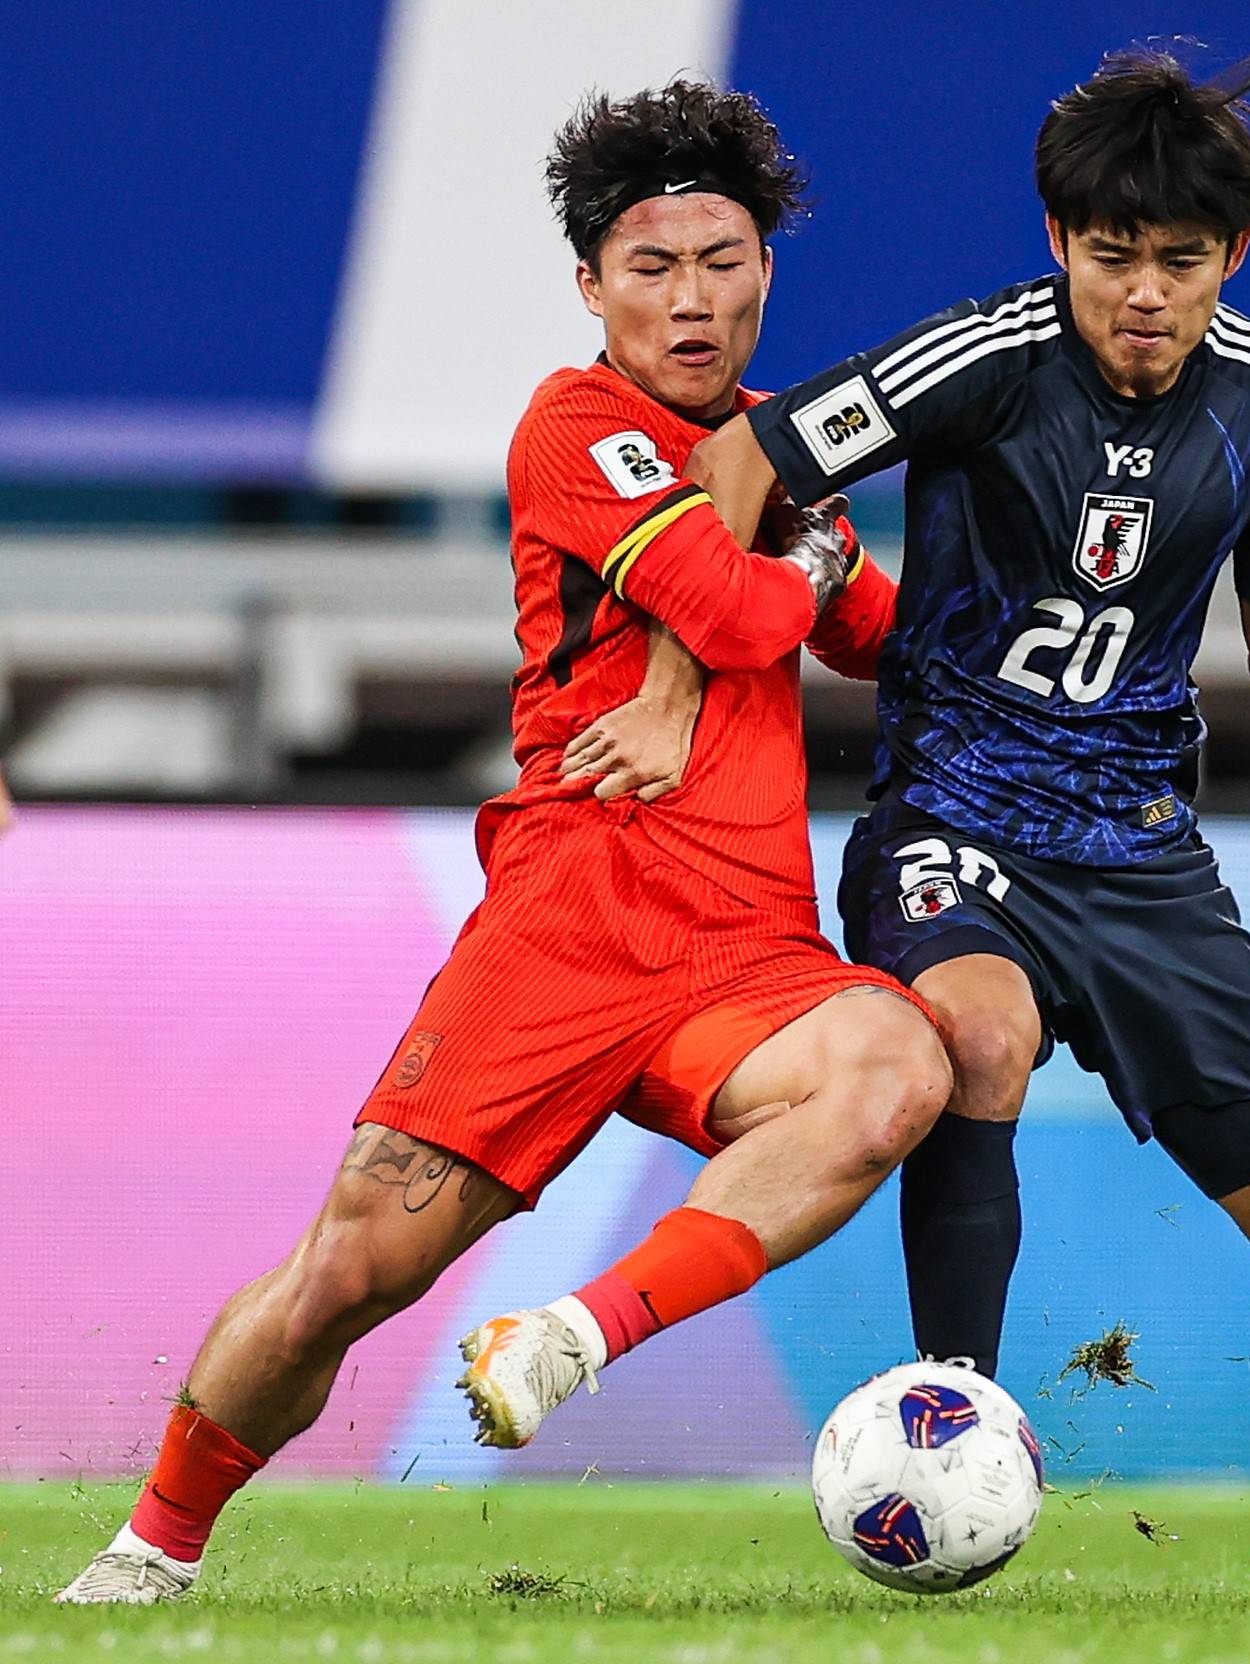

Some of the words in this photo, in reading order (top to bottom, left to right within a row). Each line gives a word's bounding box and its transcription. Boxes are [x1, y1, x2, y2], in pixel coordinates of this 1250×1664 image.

[1103, 442, 1154, 478] Y-3
[1100, 499, 1135, 510] JAPAN
[997, 597, 1135, 703] 20
